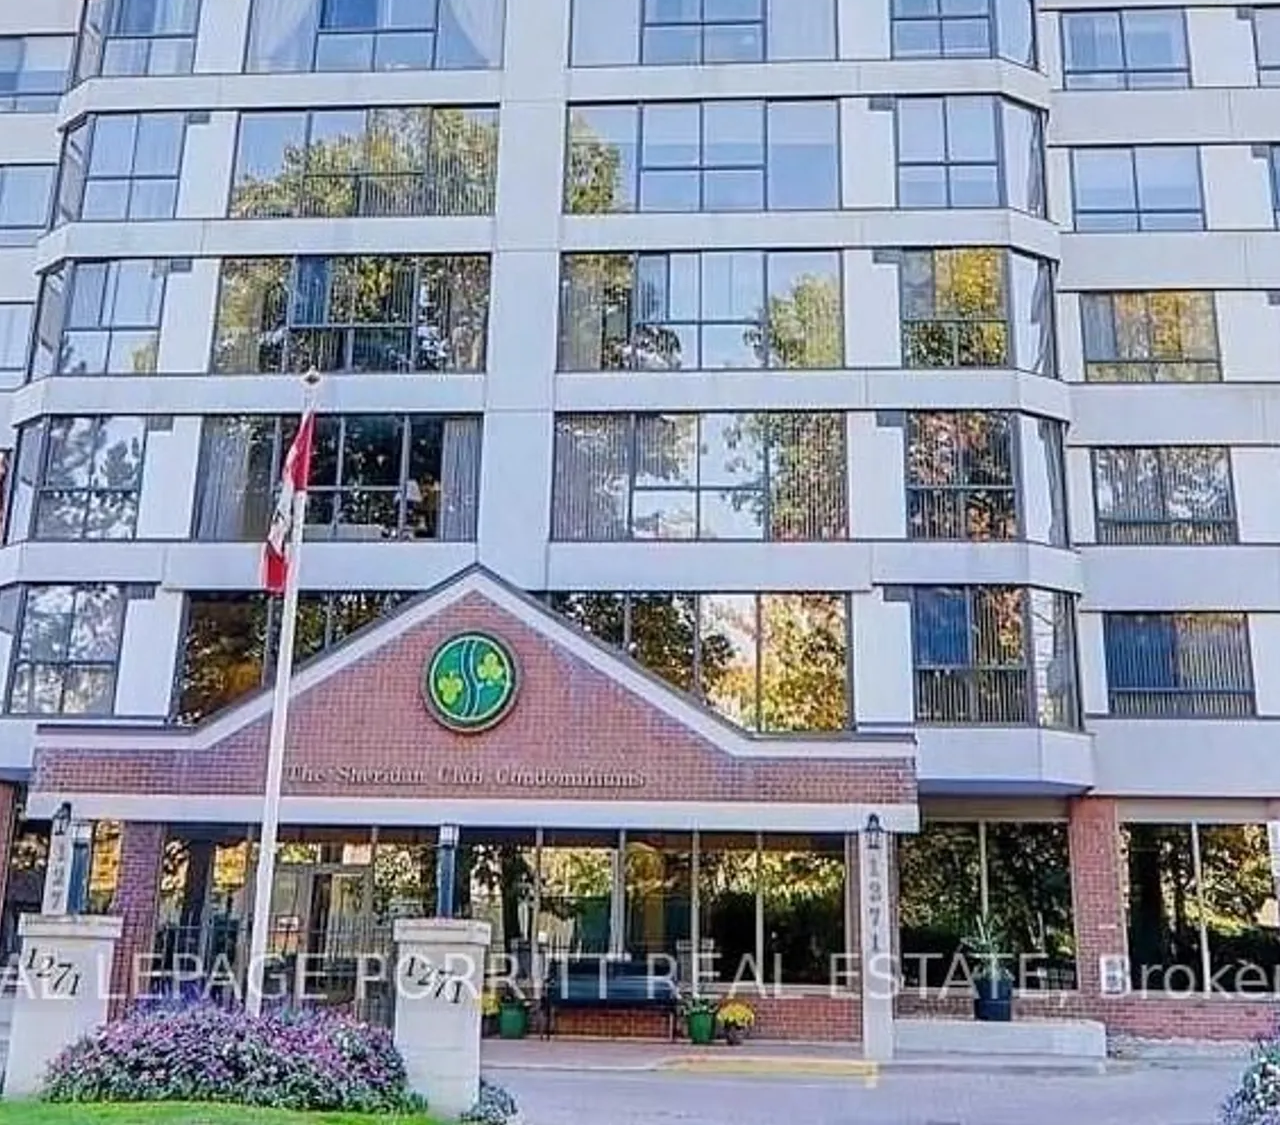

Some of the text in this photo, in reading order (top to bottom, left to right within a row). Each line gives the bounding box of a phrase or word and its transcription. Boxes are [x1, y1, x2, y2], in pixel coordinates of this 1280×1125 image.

[287, 761, 325, 782] The
[334, 763, 426, 785] Sheridan
[495, 765, 646, 788] Condominiums
[25, 947, 82, 997] 1271
[404, 956, 463, 1005] 1271
